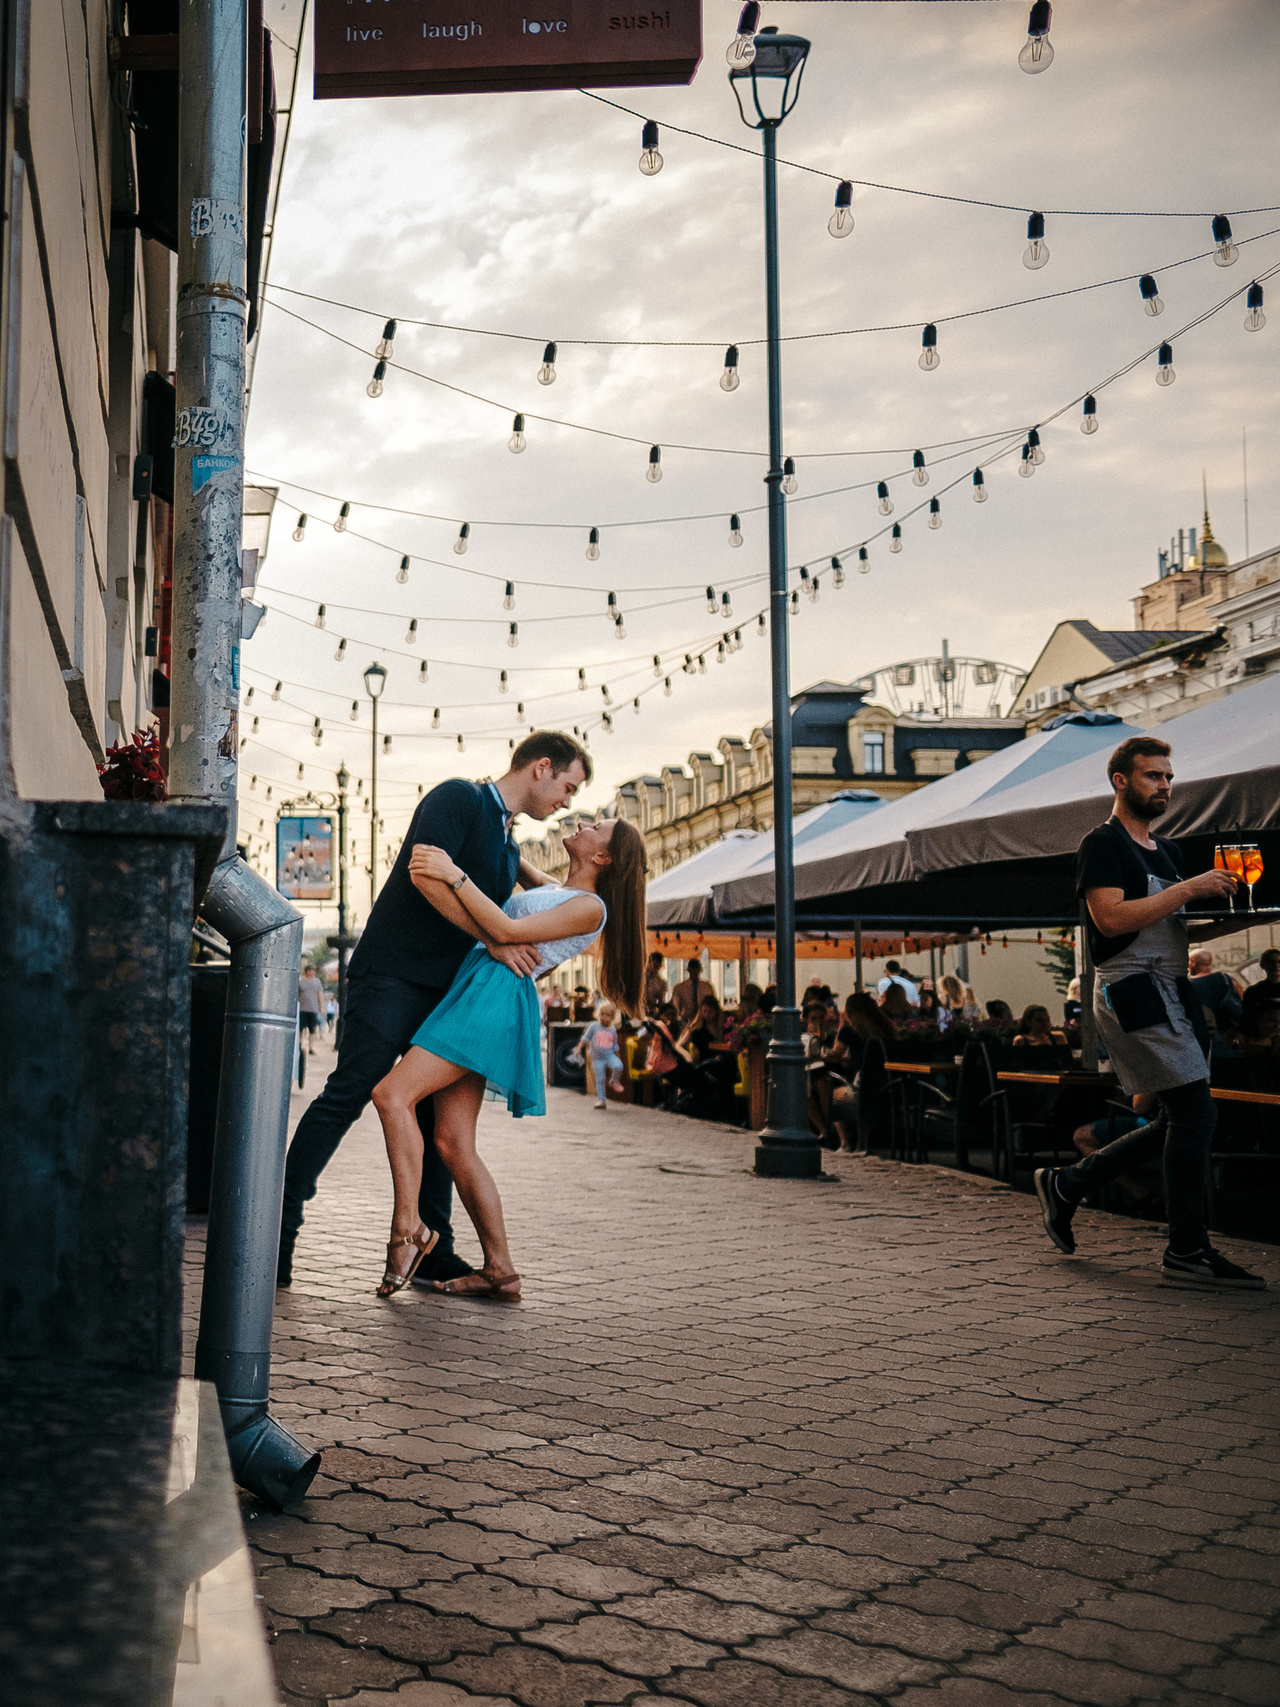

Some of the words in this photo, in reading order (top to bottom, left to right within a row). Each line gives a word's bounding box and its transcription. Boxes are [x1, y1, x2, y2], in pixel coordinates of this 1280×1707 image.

[346, 25, 384, 42] live
[422, 19, 484, 41] laugh
[608, 11, 671, 31] sushi
